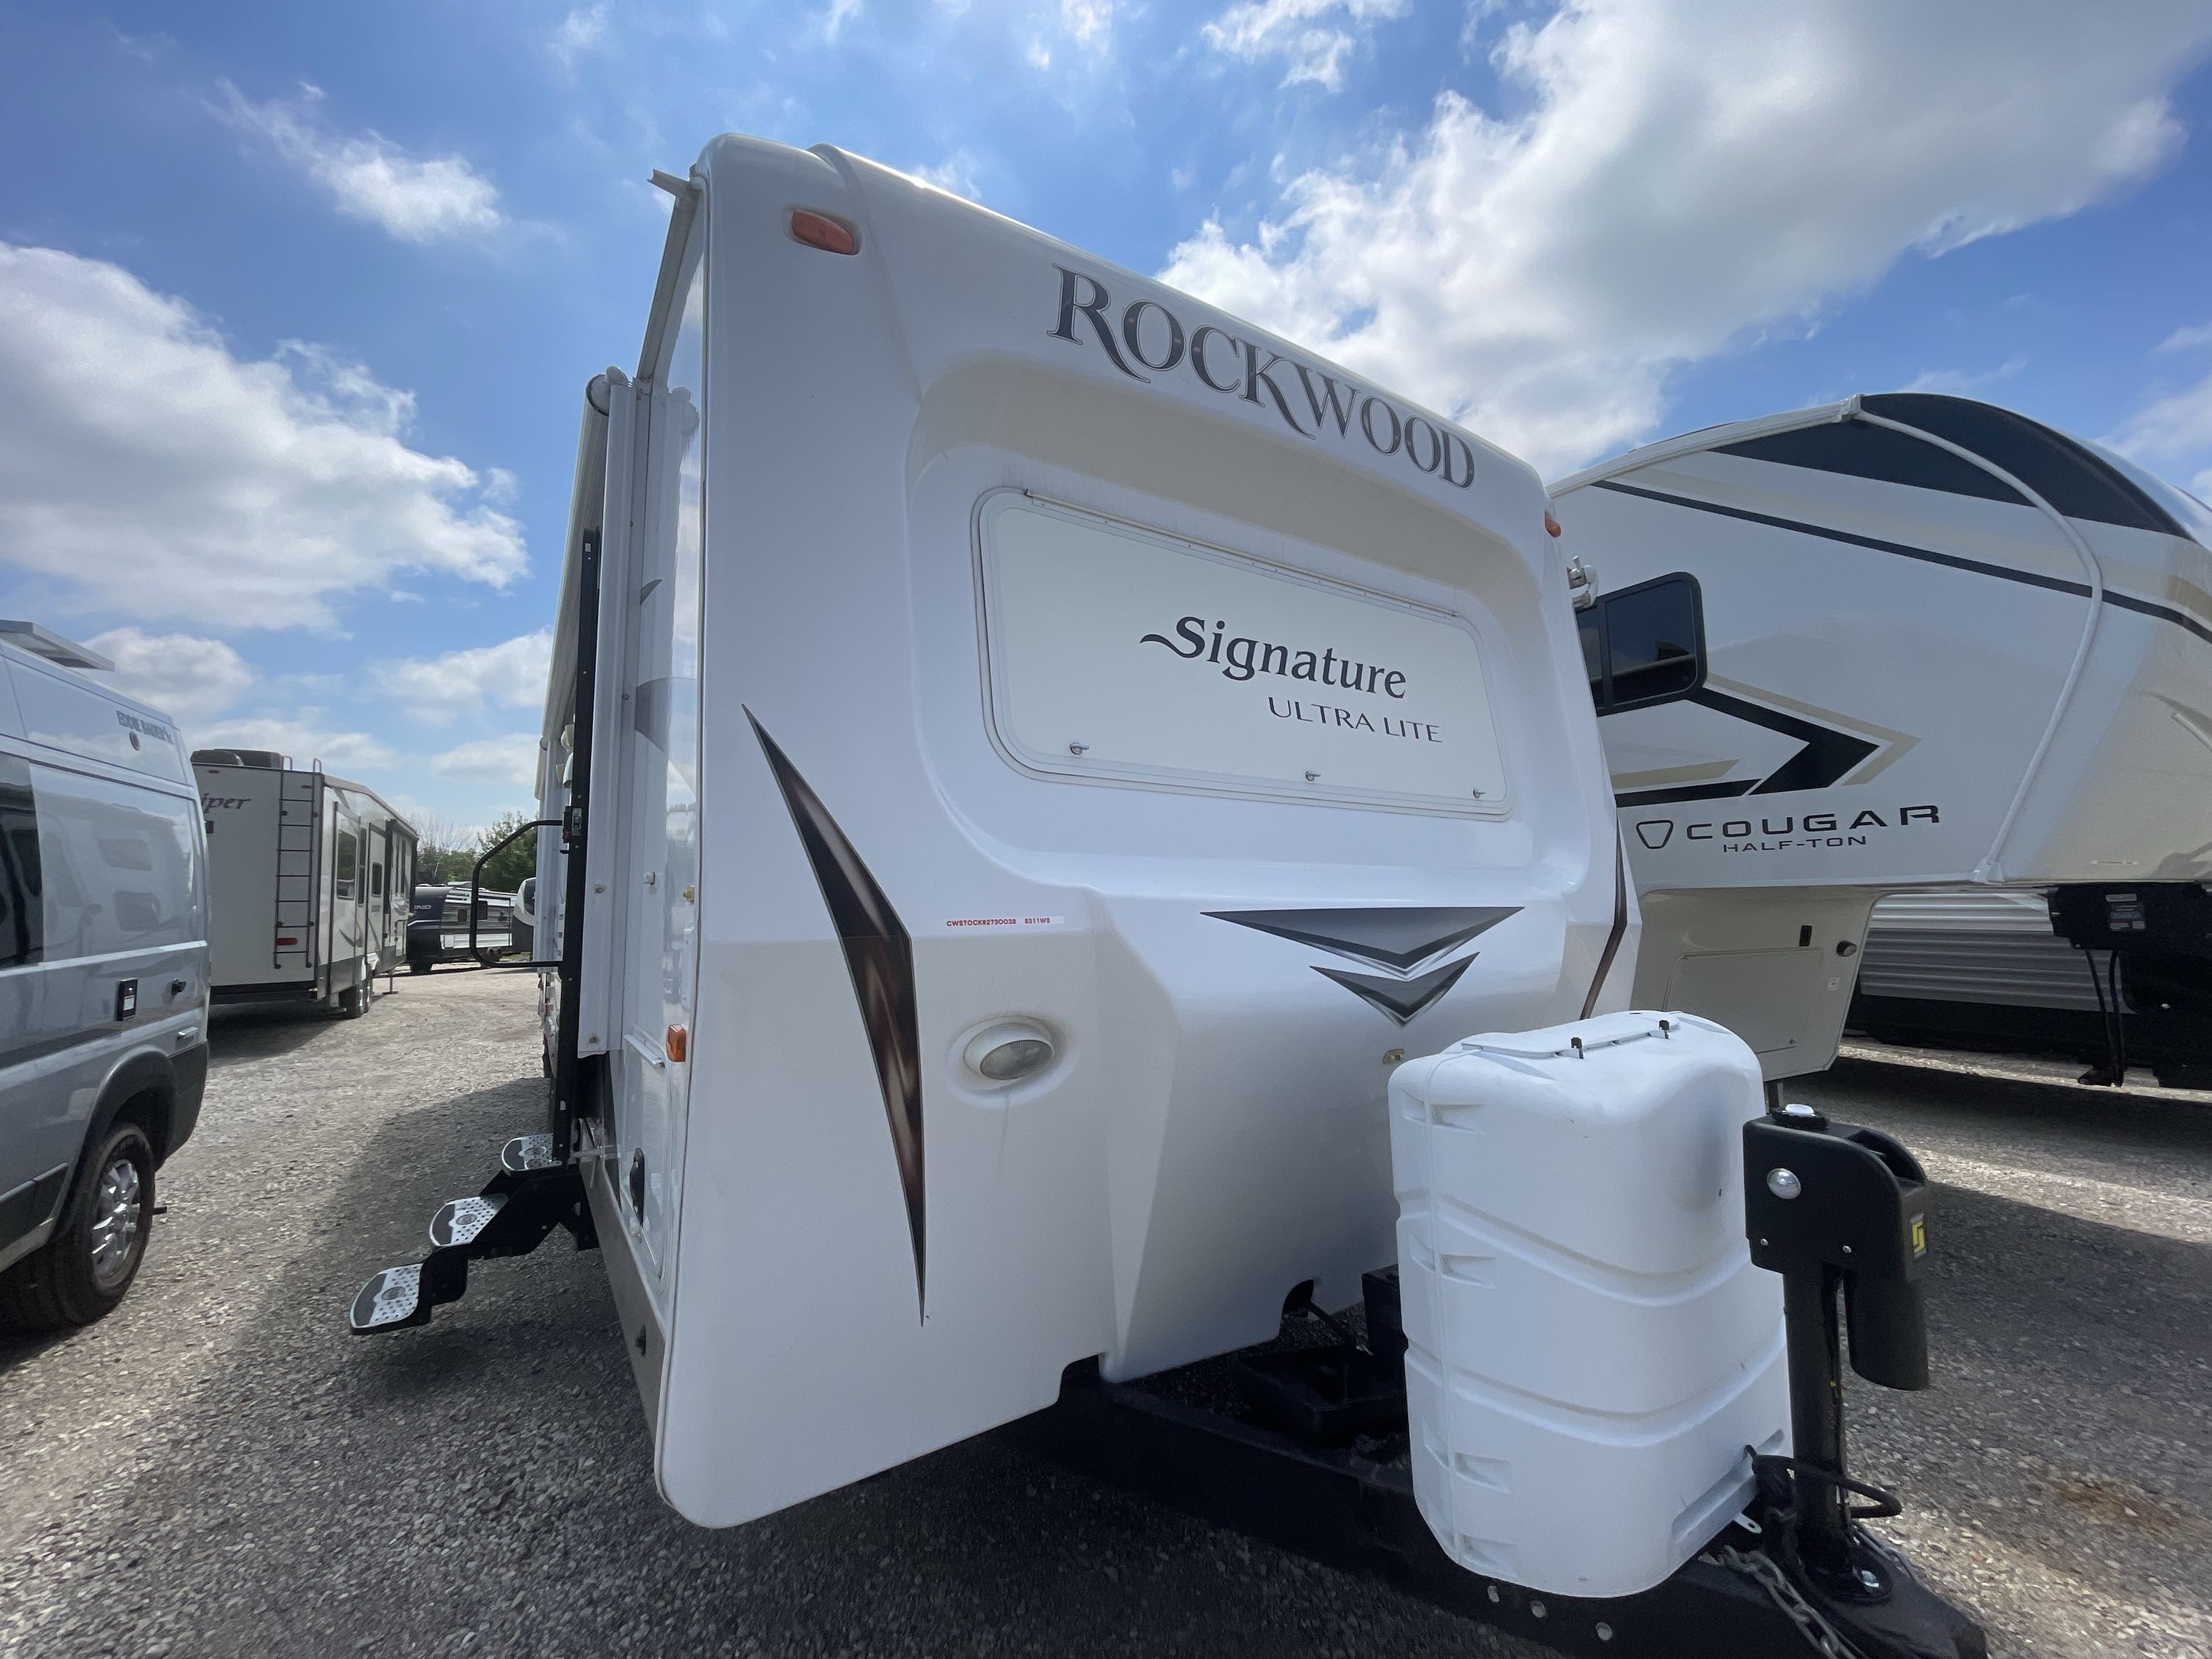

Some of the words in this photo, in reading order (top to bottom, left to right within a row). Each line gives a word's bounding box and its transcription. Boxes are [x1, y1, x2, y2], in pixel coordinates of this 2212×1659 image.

[1046, 262, 1475, 490] ROCKWOOD
[1140, 616, 1407, 699] Signature
[1267, 697, 1376, 733] ULTRA
[1383, 717, 1443, 743] LITE
[1686, 804, 1941, 840] COUGAR
[1723, 835, 1866, 852] HALF-TON
